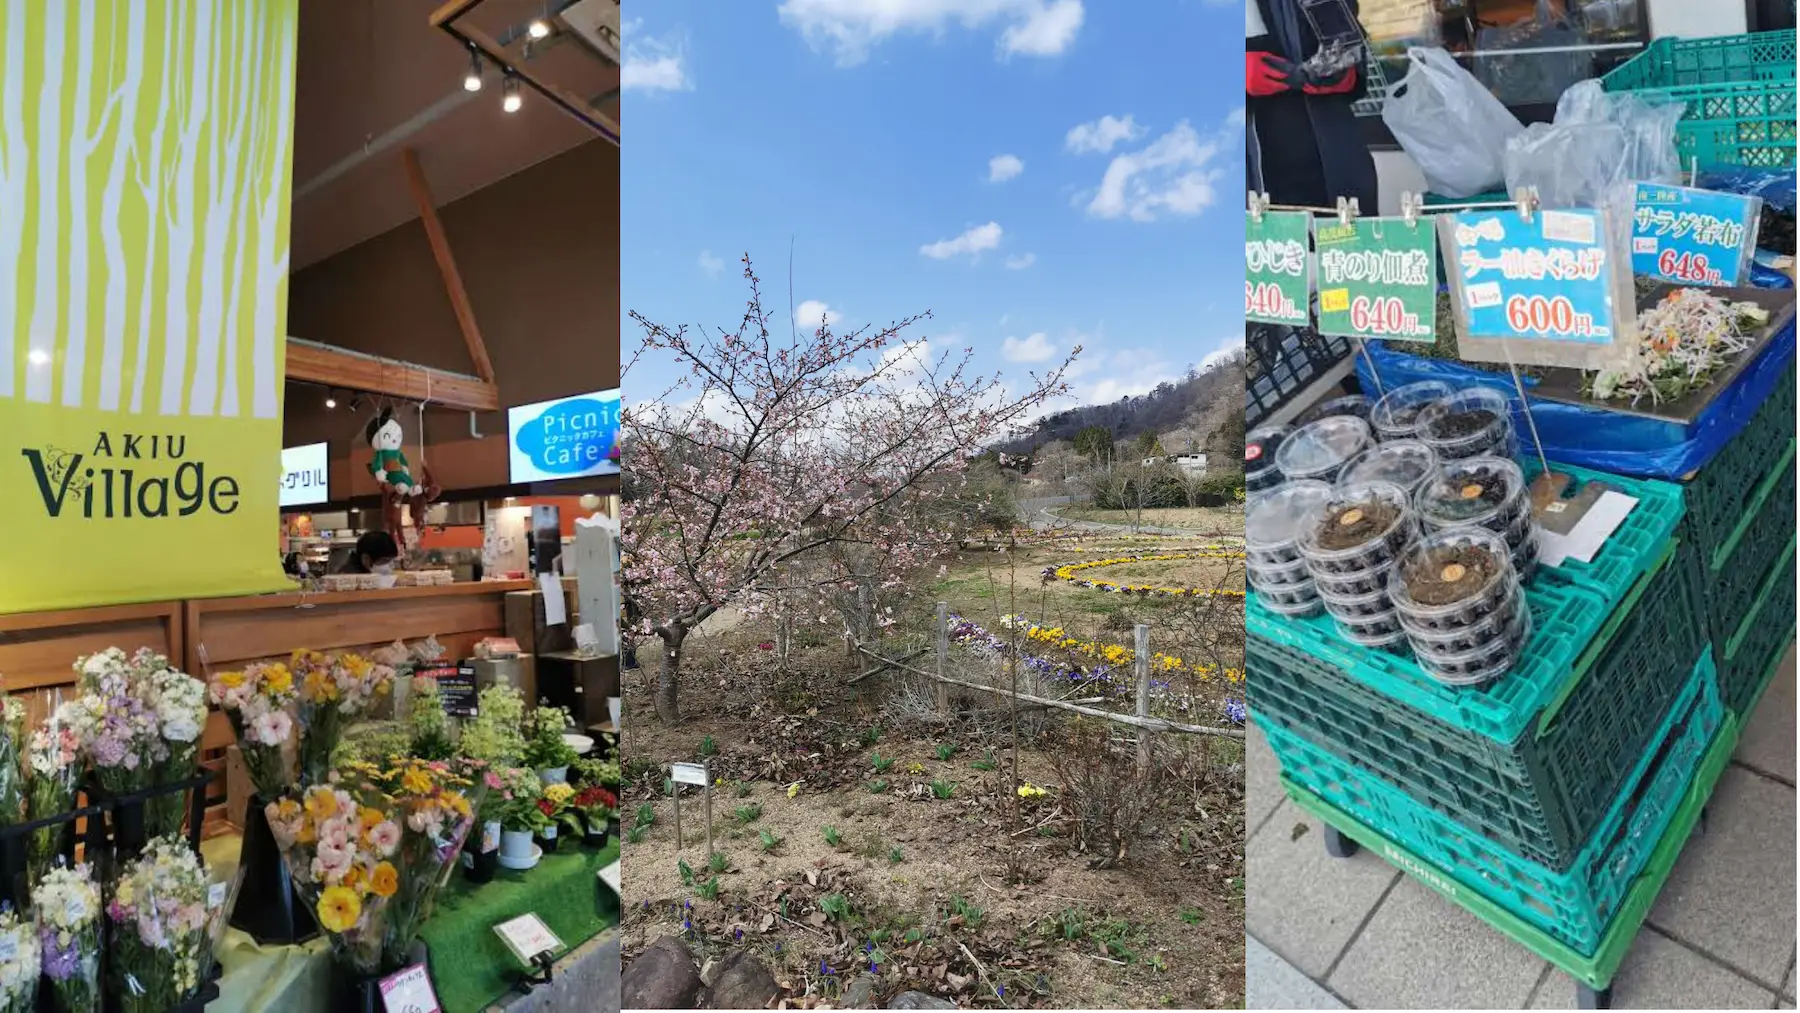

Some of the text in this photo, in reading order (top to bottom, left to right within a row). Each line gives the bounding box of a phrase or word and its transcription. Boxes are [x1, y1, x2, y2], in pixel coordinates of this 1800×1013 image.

[1634, 206, 1743, 249] サラダ若布
[1322, 248, 1429, 286] 青のり佃煮
[1506, 294, 1592, 336] 600円
[544, 405, 620, 434] Picnic
[93, 431, 186, 459] AKIU
[544, 443, 598, 466] Cafe
[21, 446, 240, 518] Village
[280, 468, 326, 489] グリル
